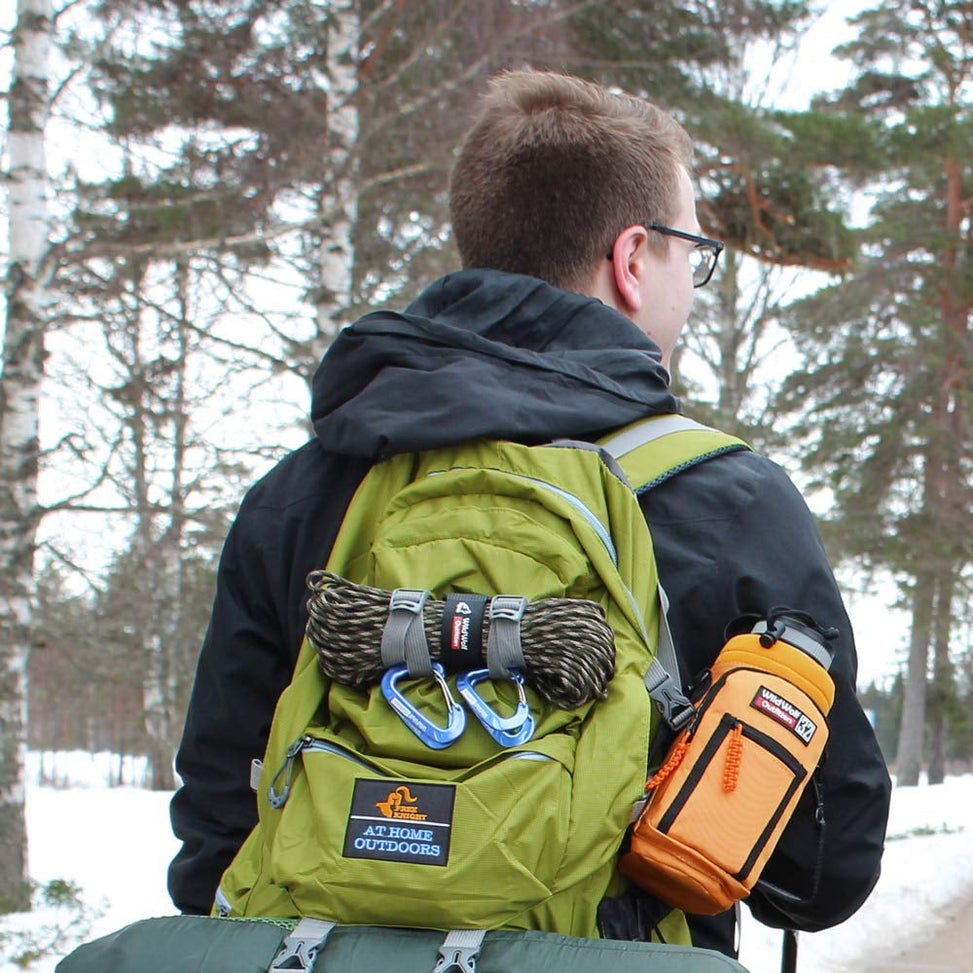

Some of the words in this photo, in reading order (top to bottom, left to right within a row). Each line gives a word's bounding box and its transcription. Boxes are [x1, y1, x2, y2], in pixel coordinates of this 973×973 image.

[797, 716, 815, 740] 32
[363, 825, 386, 837] AT
[387, 826, 433, 842] HOME
[354, 837, 440, 857] OUTDOORS
